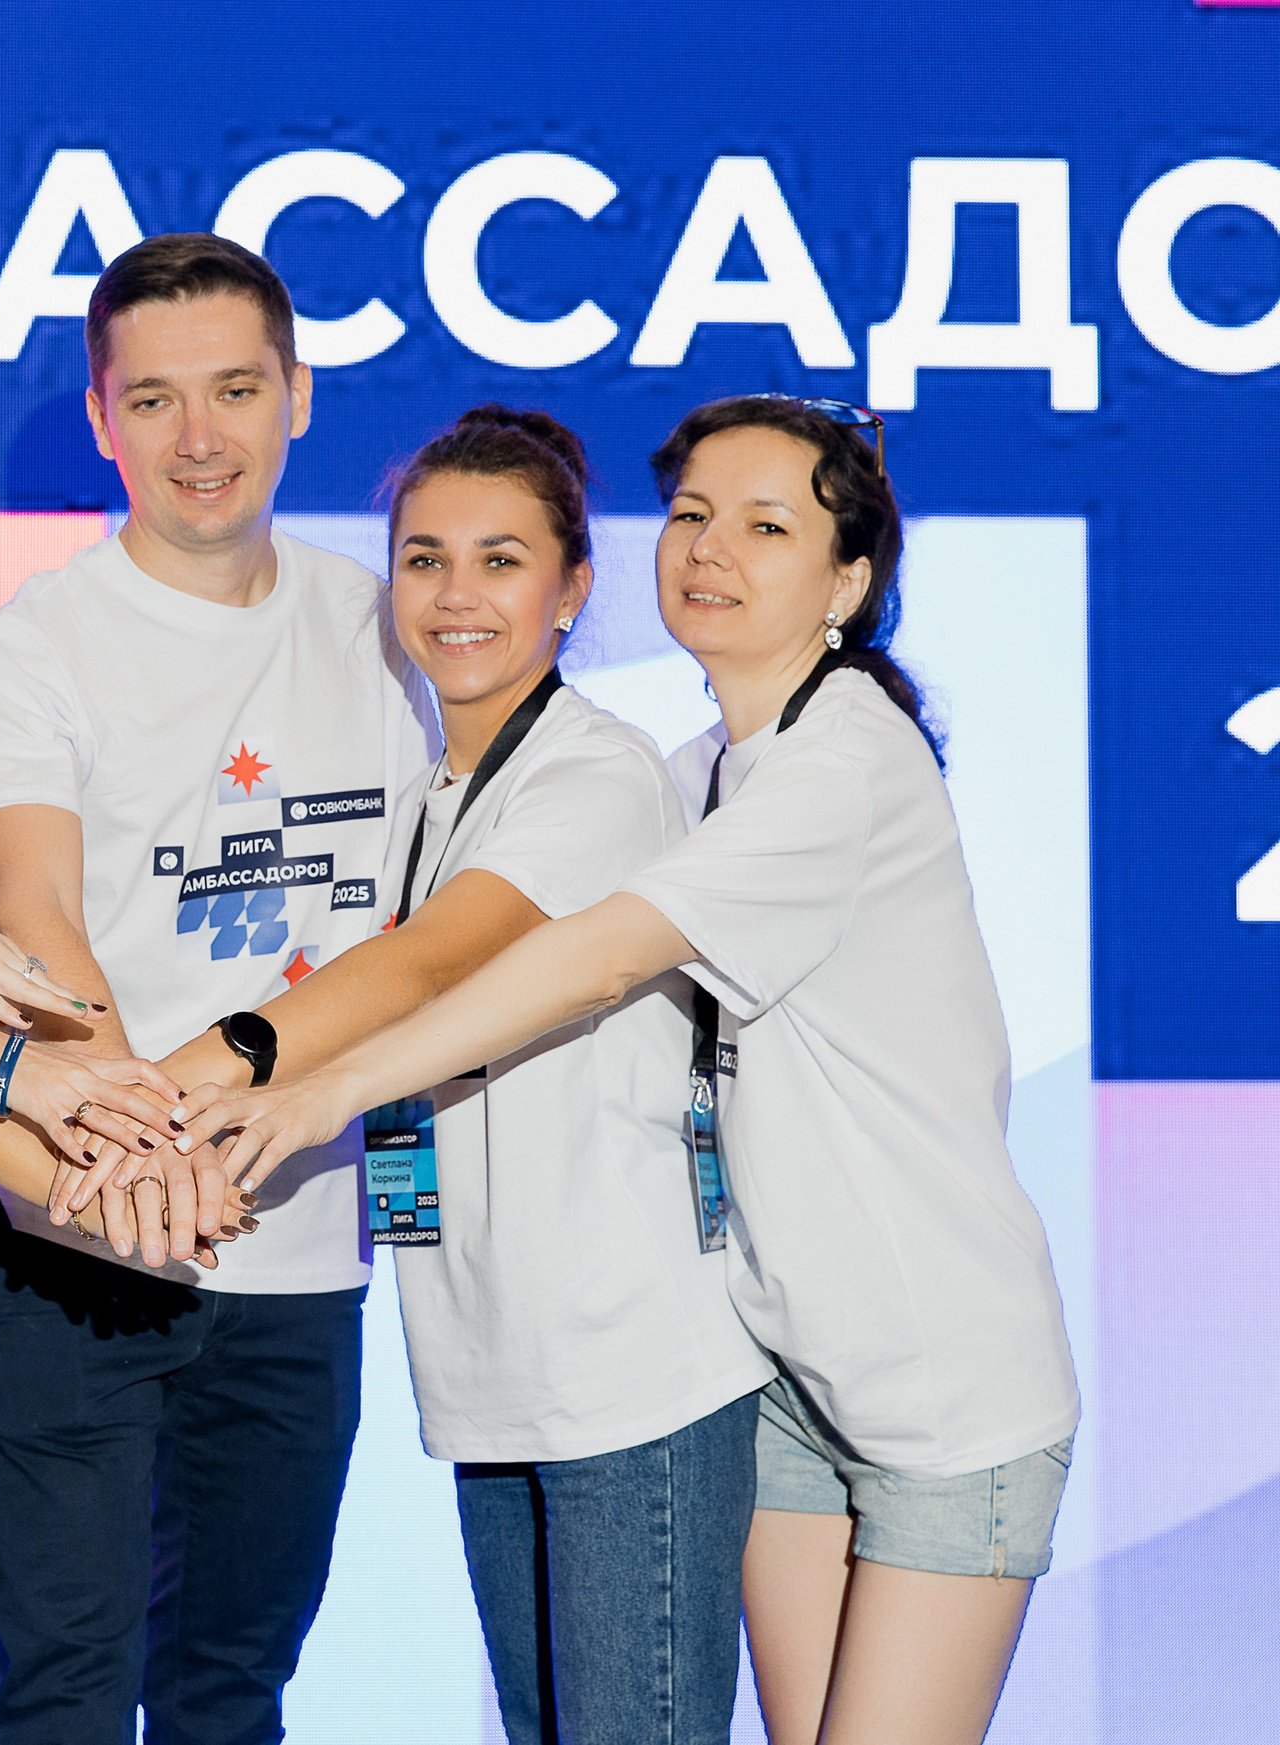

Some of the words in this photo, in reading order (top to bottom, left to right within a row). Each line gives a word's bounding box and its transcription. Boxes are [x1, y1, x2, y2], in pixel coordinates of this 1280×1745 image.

[308, 796, 383, 816] СОВКОМБАНК
[227, 837, 276, 857] ЛИГА
[182, 862, 328, 895] АМБАССАДОРОВ
[333, 885, 370, 903] 2025
[370, 1159, 413, 1170] Светлана
[372, 1173, 410, 1185] Коркина
[417, 1195, 438, 1206] 2025
[393, 1214, 414, 1225] ЛИГА
[373, 1232, 438, 1242] АМБАССАДОРОВ
